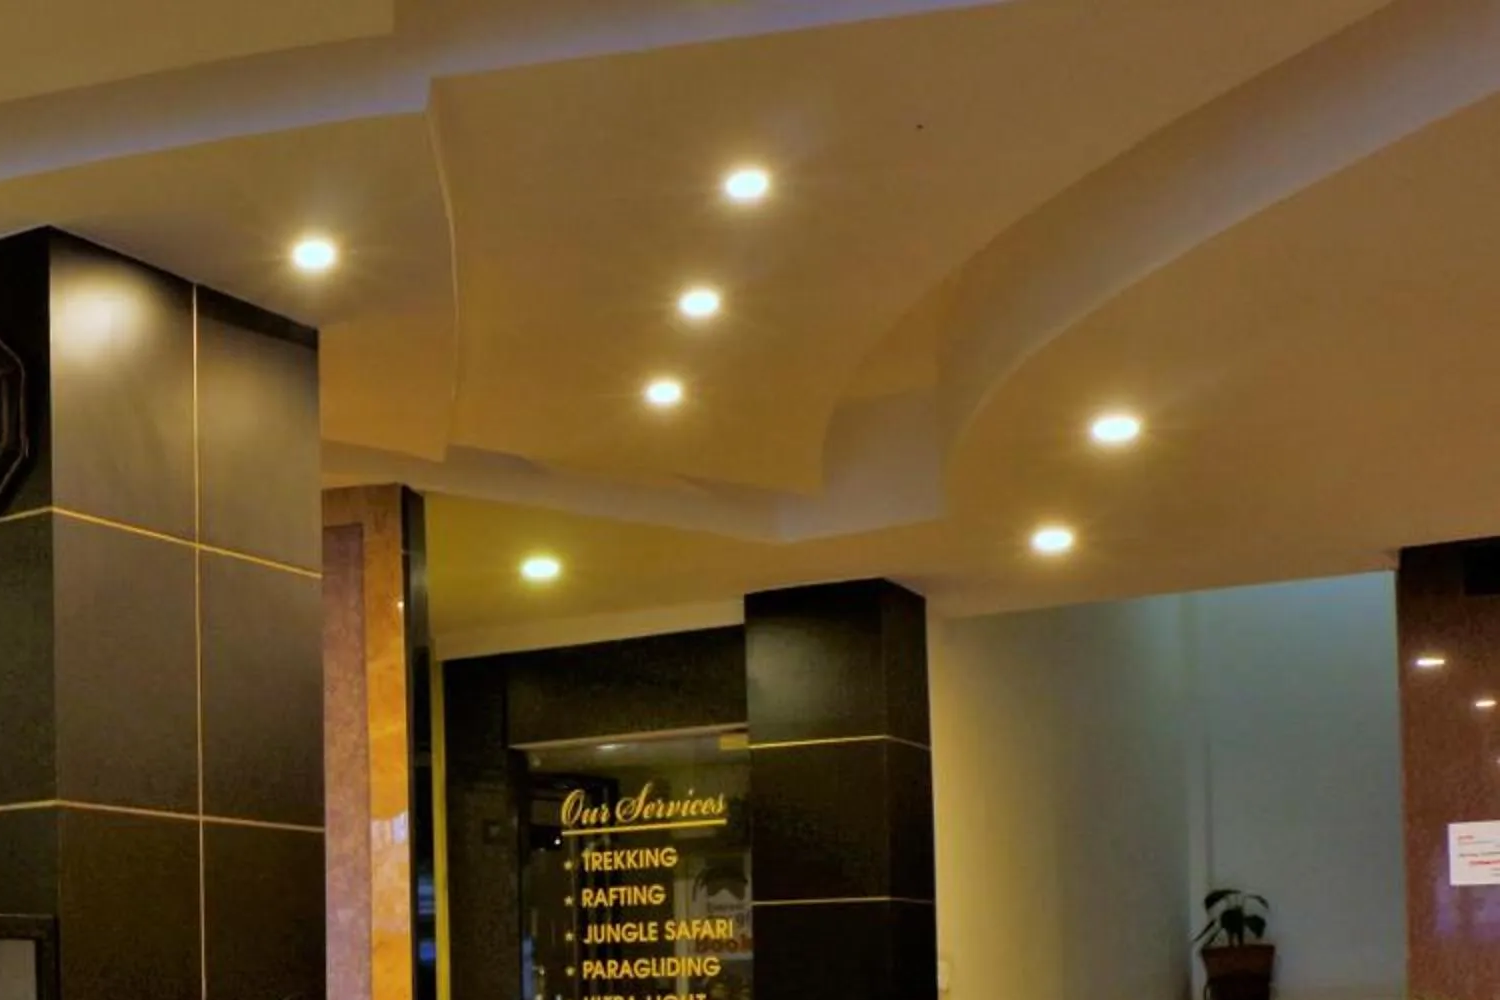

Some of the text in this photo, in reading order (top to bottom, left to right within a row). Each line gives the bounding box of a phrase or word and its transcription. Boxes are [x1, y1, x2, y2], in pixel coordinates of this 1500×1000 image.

[561, 782, 727, 828] Our Services
[581, 847, 678, 872] TREKKING
[581, 885, 666, 908] RAFTING
[583, 918, 734, 945] JUNGLE SAFARI
[583, 956, 721, 980] PARAGLIDING
